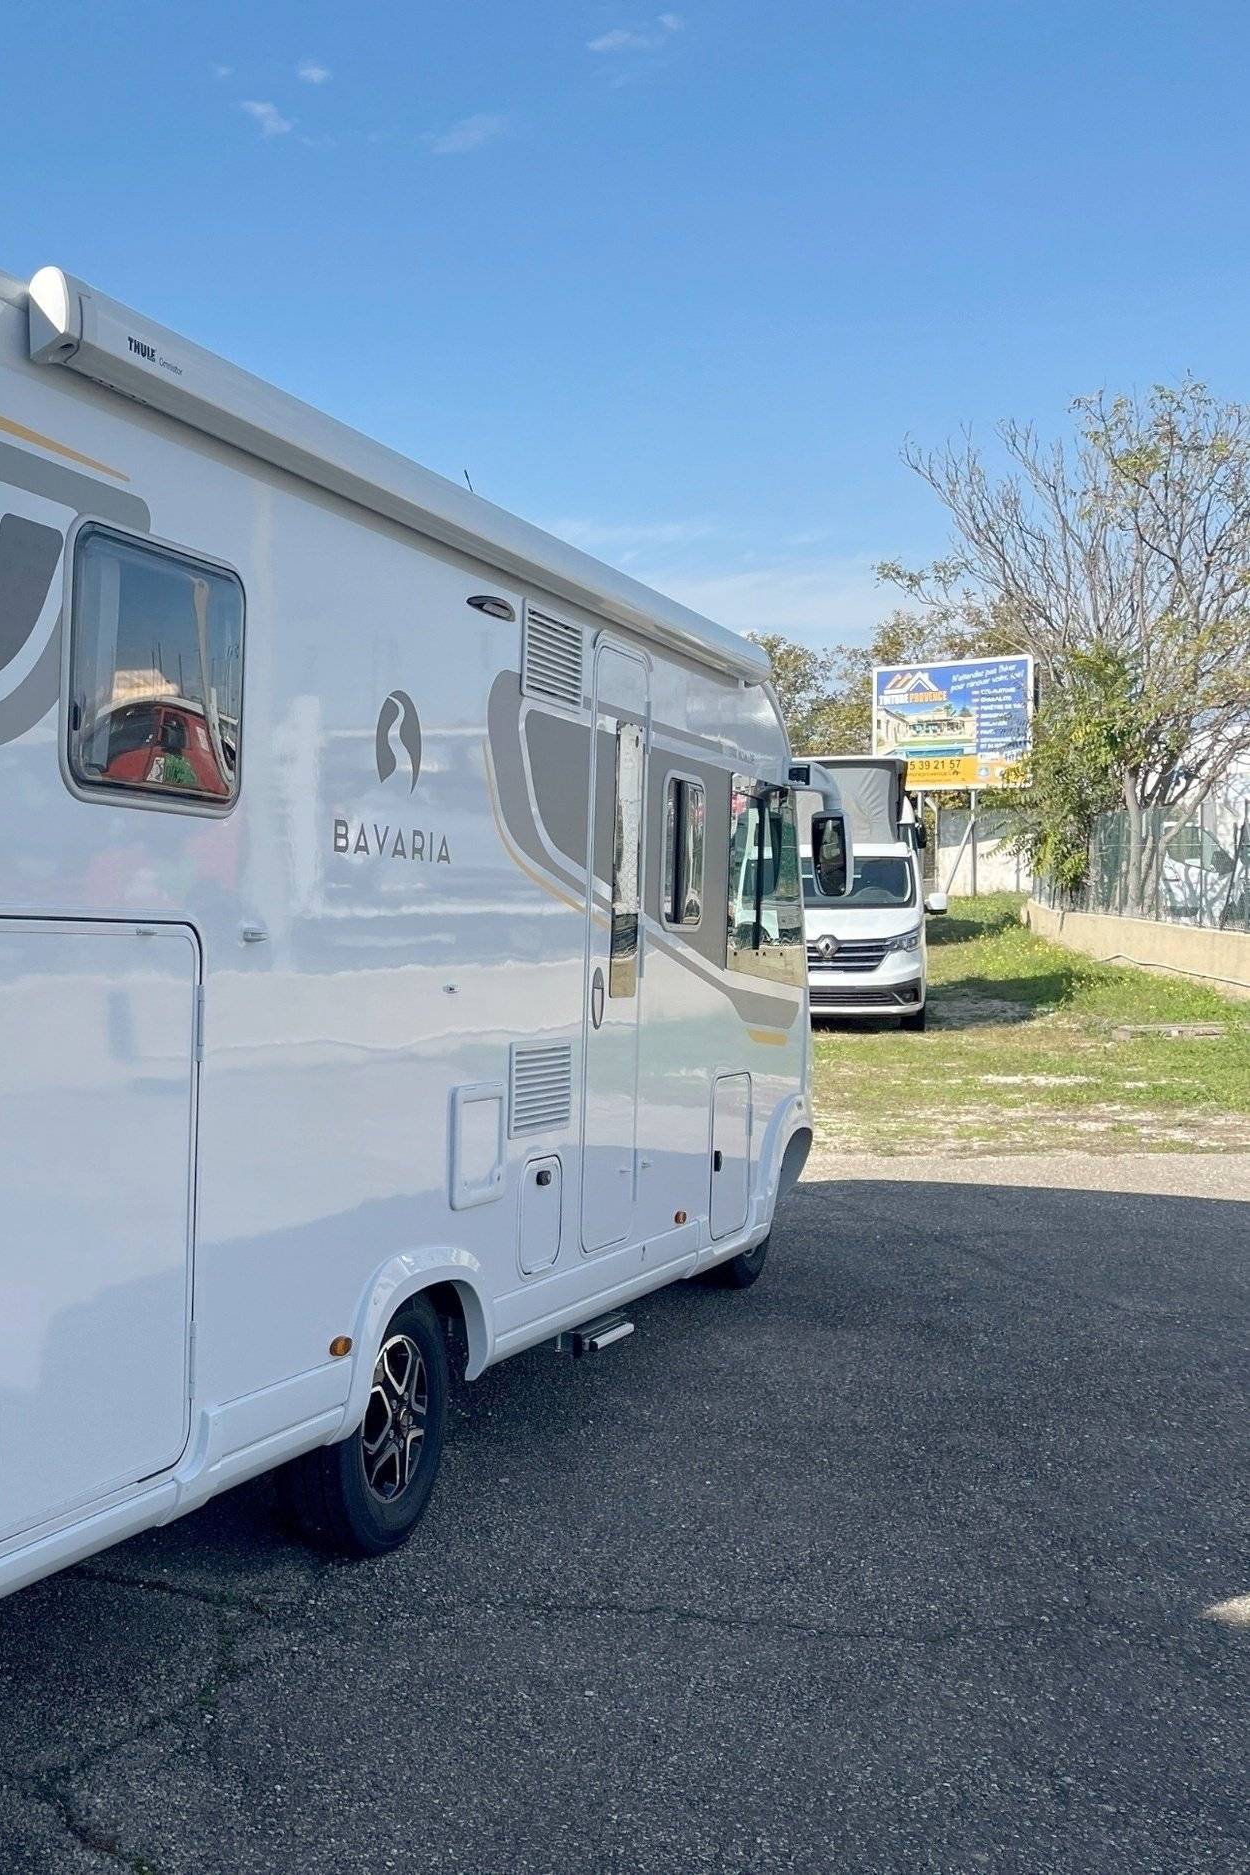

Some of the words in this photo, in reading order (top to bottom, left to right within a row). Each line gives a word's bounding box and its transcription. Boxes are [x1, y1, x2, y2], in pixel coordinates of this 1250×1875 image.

[128, 336, 156, 362] THULE
[919, 760, 930, 770] 39
[933, 760, 945, 769] 21
[949, 759, 961, 769] 57
[334, 819, 450, 864] BAVARIA
